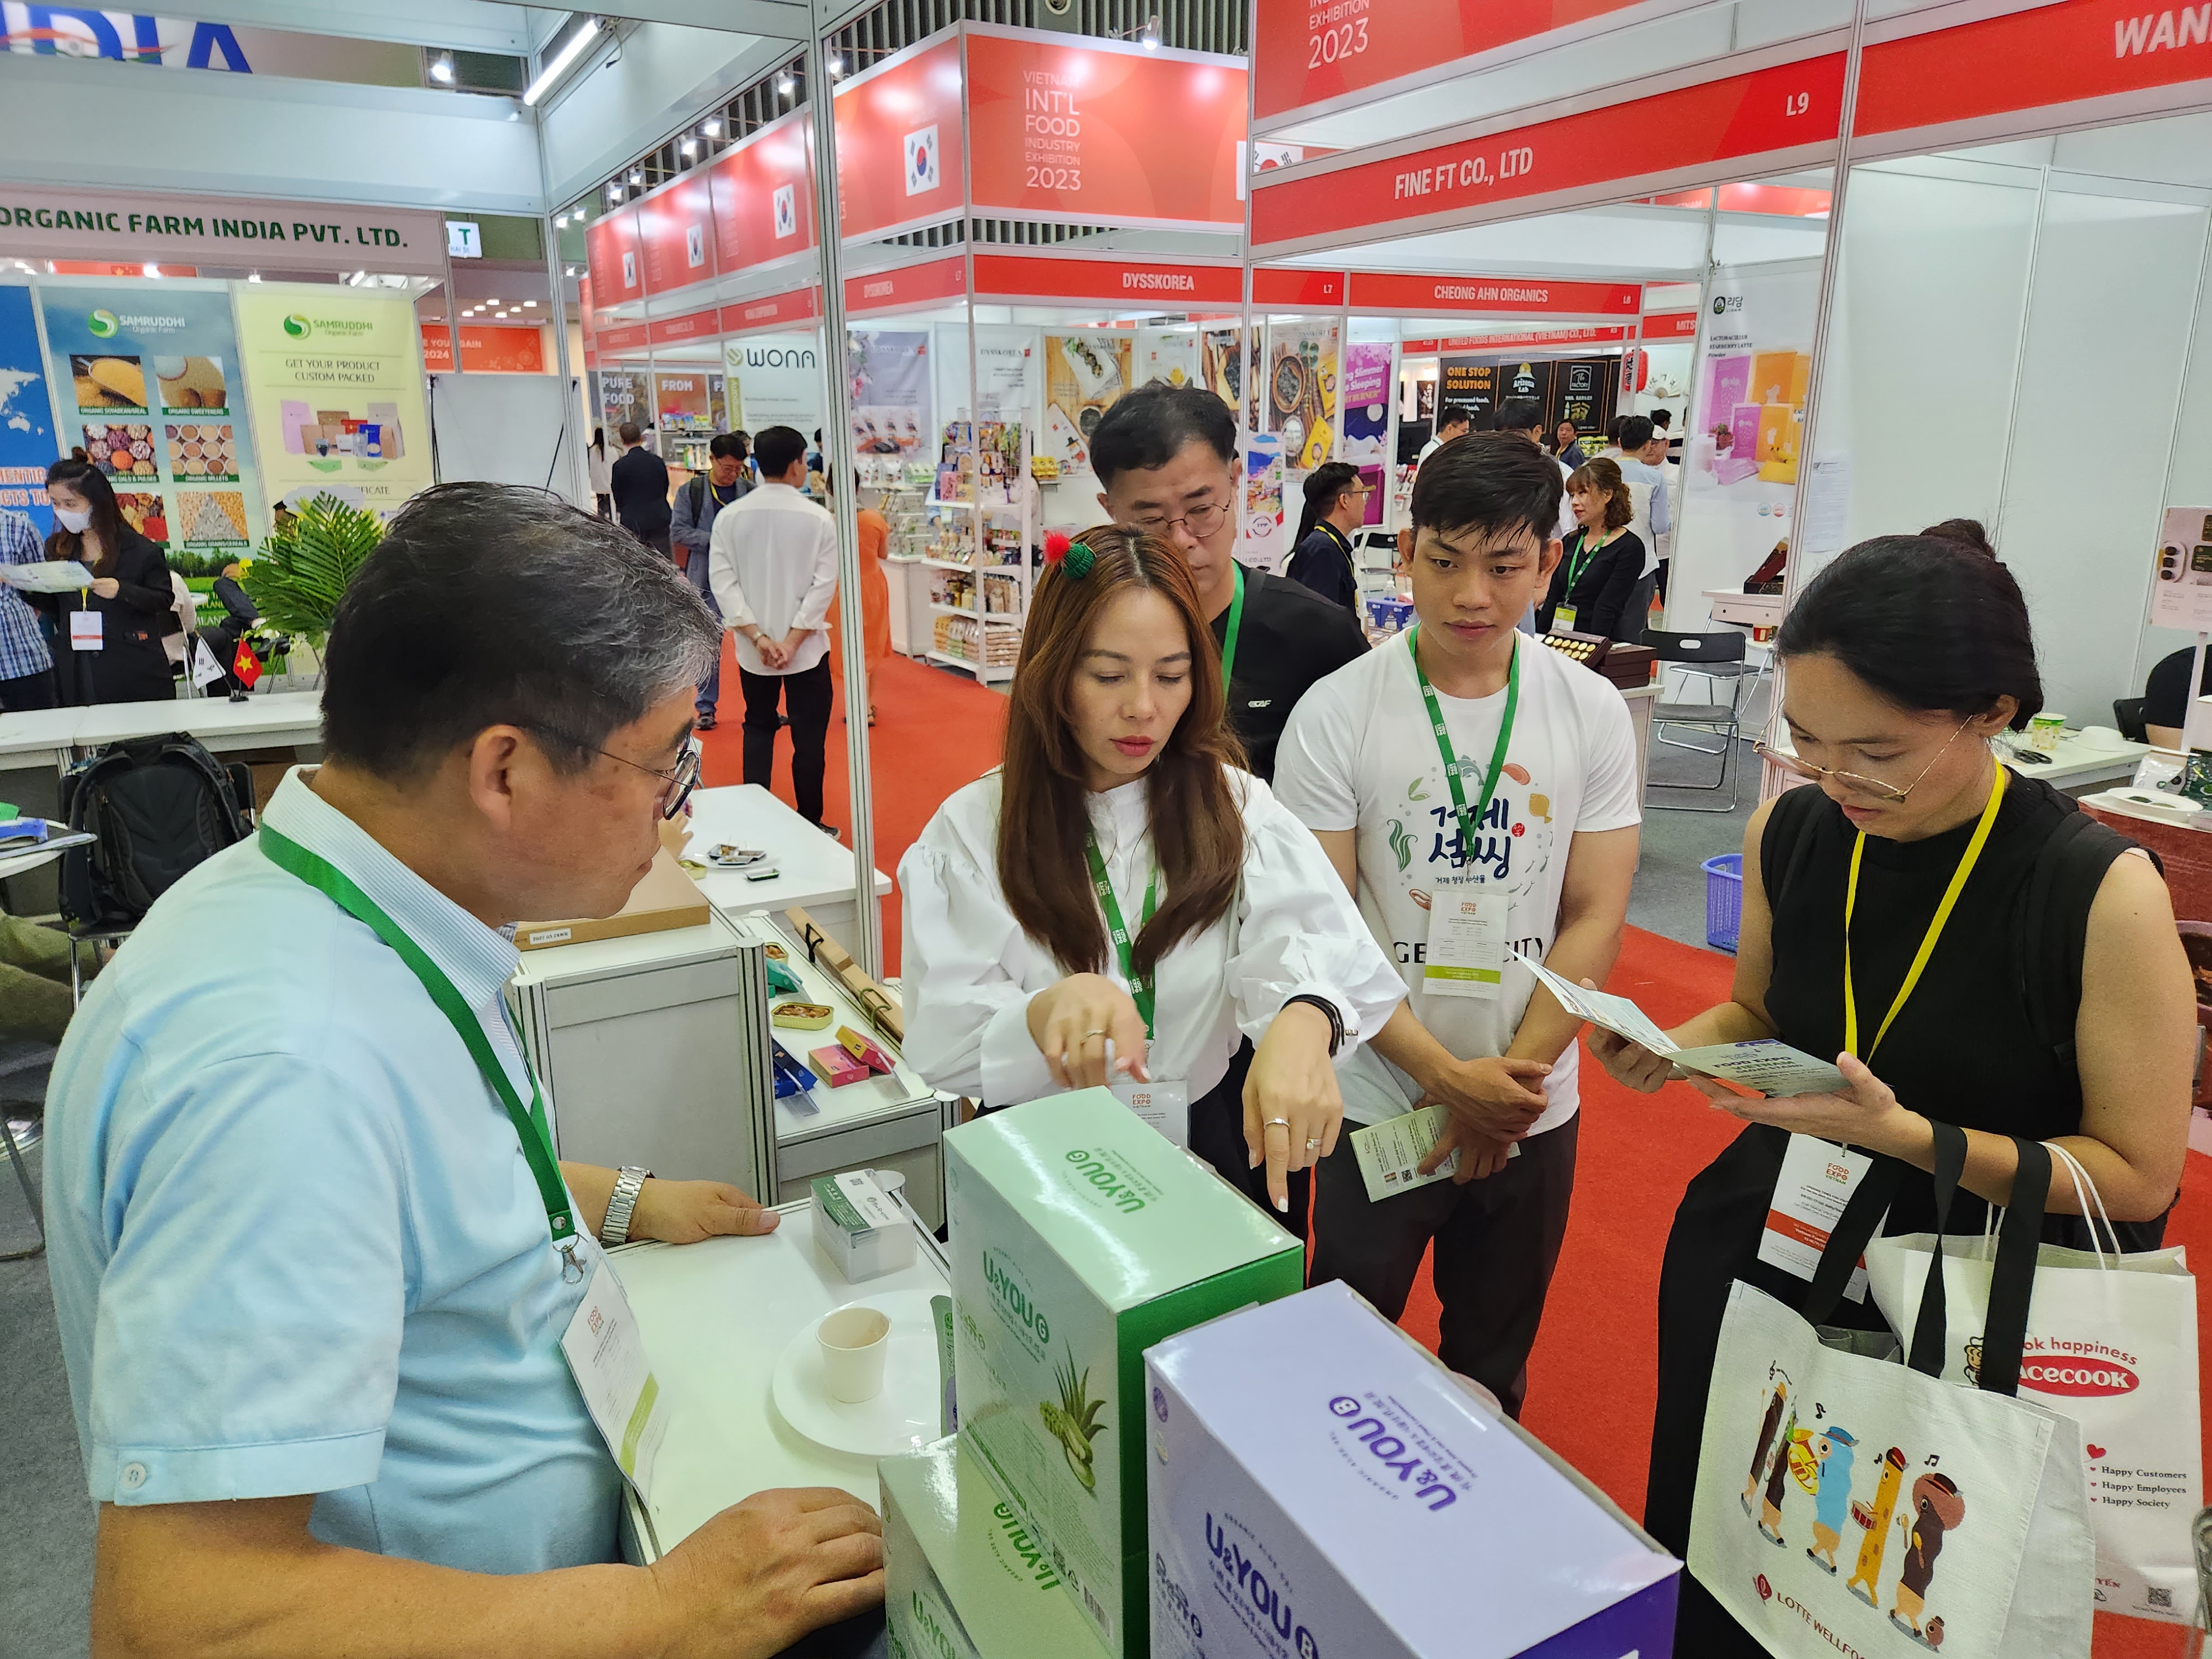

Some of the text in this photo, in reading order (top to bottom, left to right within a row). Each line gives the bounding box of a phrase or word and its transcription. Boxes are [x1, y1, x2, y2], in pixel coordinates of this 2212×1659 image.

[1309, 0, 1370, 30] EXHIBITION
[2115, 3, 2212, 59] WAN
[1308, 17, 1369, 70] 2023
[1023, 70, 1080, 88] VIETNAM
[1025, 87, 1080, 116] INT'L
[1786, 92, 1809, 118] L9
[1025, 115, 1080, 138] FOOD
[1024, 137, 1081, 153] INDUSTRY
[1025, 152, 1081, 166] EXHIBITION
[1025, 166, 1082, 191] 2023
[1395, 168, 1431, 200] FINE
[1435, 163, 1457, 192] FT
[1499, 147, 1533, 178] LTD
[128, 214, 205, 236] FARM
[212, 218, 286, 241] INDIA
[293, 223, 349, 244] PVT.
[357, 227, 408, 248] LTD.
[1122, 272, 1195, 291] DYSSKOREA
[1323, 284, 1333, 294] L7
[1434, 285, 1548, 303] CHEONG AHN ORGANICS
[119, 315, 185, 327] SAMRUDDHI
[313, 320, 373, 331] SAMRUDDHI
[1676, 320, 1696, 330] MITS
[285, 359, 380, 371] GET YOUR PRODUCT
[1447, 367, 1491, 377] ONE STOP
[295, 372, 374, 383] CUSTOM PACKED
[602, 376, 633, 389] PURE
[661, 380, 693, 392] FROM
[1446, 380, 1491, 390] SOLUTION
[1826, 1168, 1848, 1181] EXPO
[1828, 1162, 1849, 1175] FOOD
[1825, 1175, 1846, 1185] VIETNAM
[587, 1306, 598, 1326] FOOD
[2023, 1337, 2138, 1365] ok happiness
[1347, 1416, 1457, 1512] U&YOU
[2101, 1466, 2187, 1479] Happy Customers
[2102, 1481, 2187, 1494] Happy Employees
[2103, 1496, 2171, 1510] Happy Society
[1206, 1512, 1291, 1640] U&YOU
[913, 1590, 956, 1659] U&YO
[1777, 1593, 1866, 1659] LOTTE WELLFO
